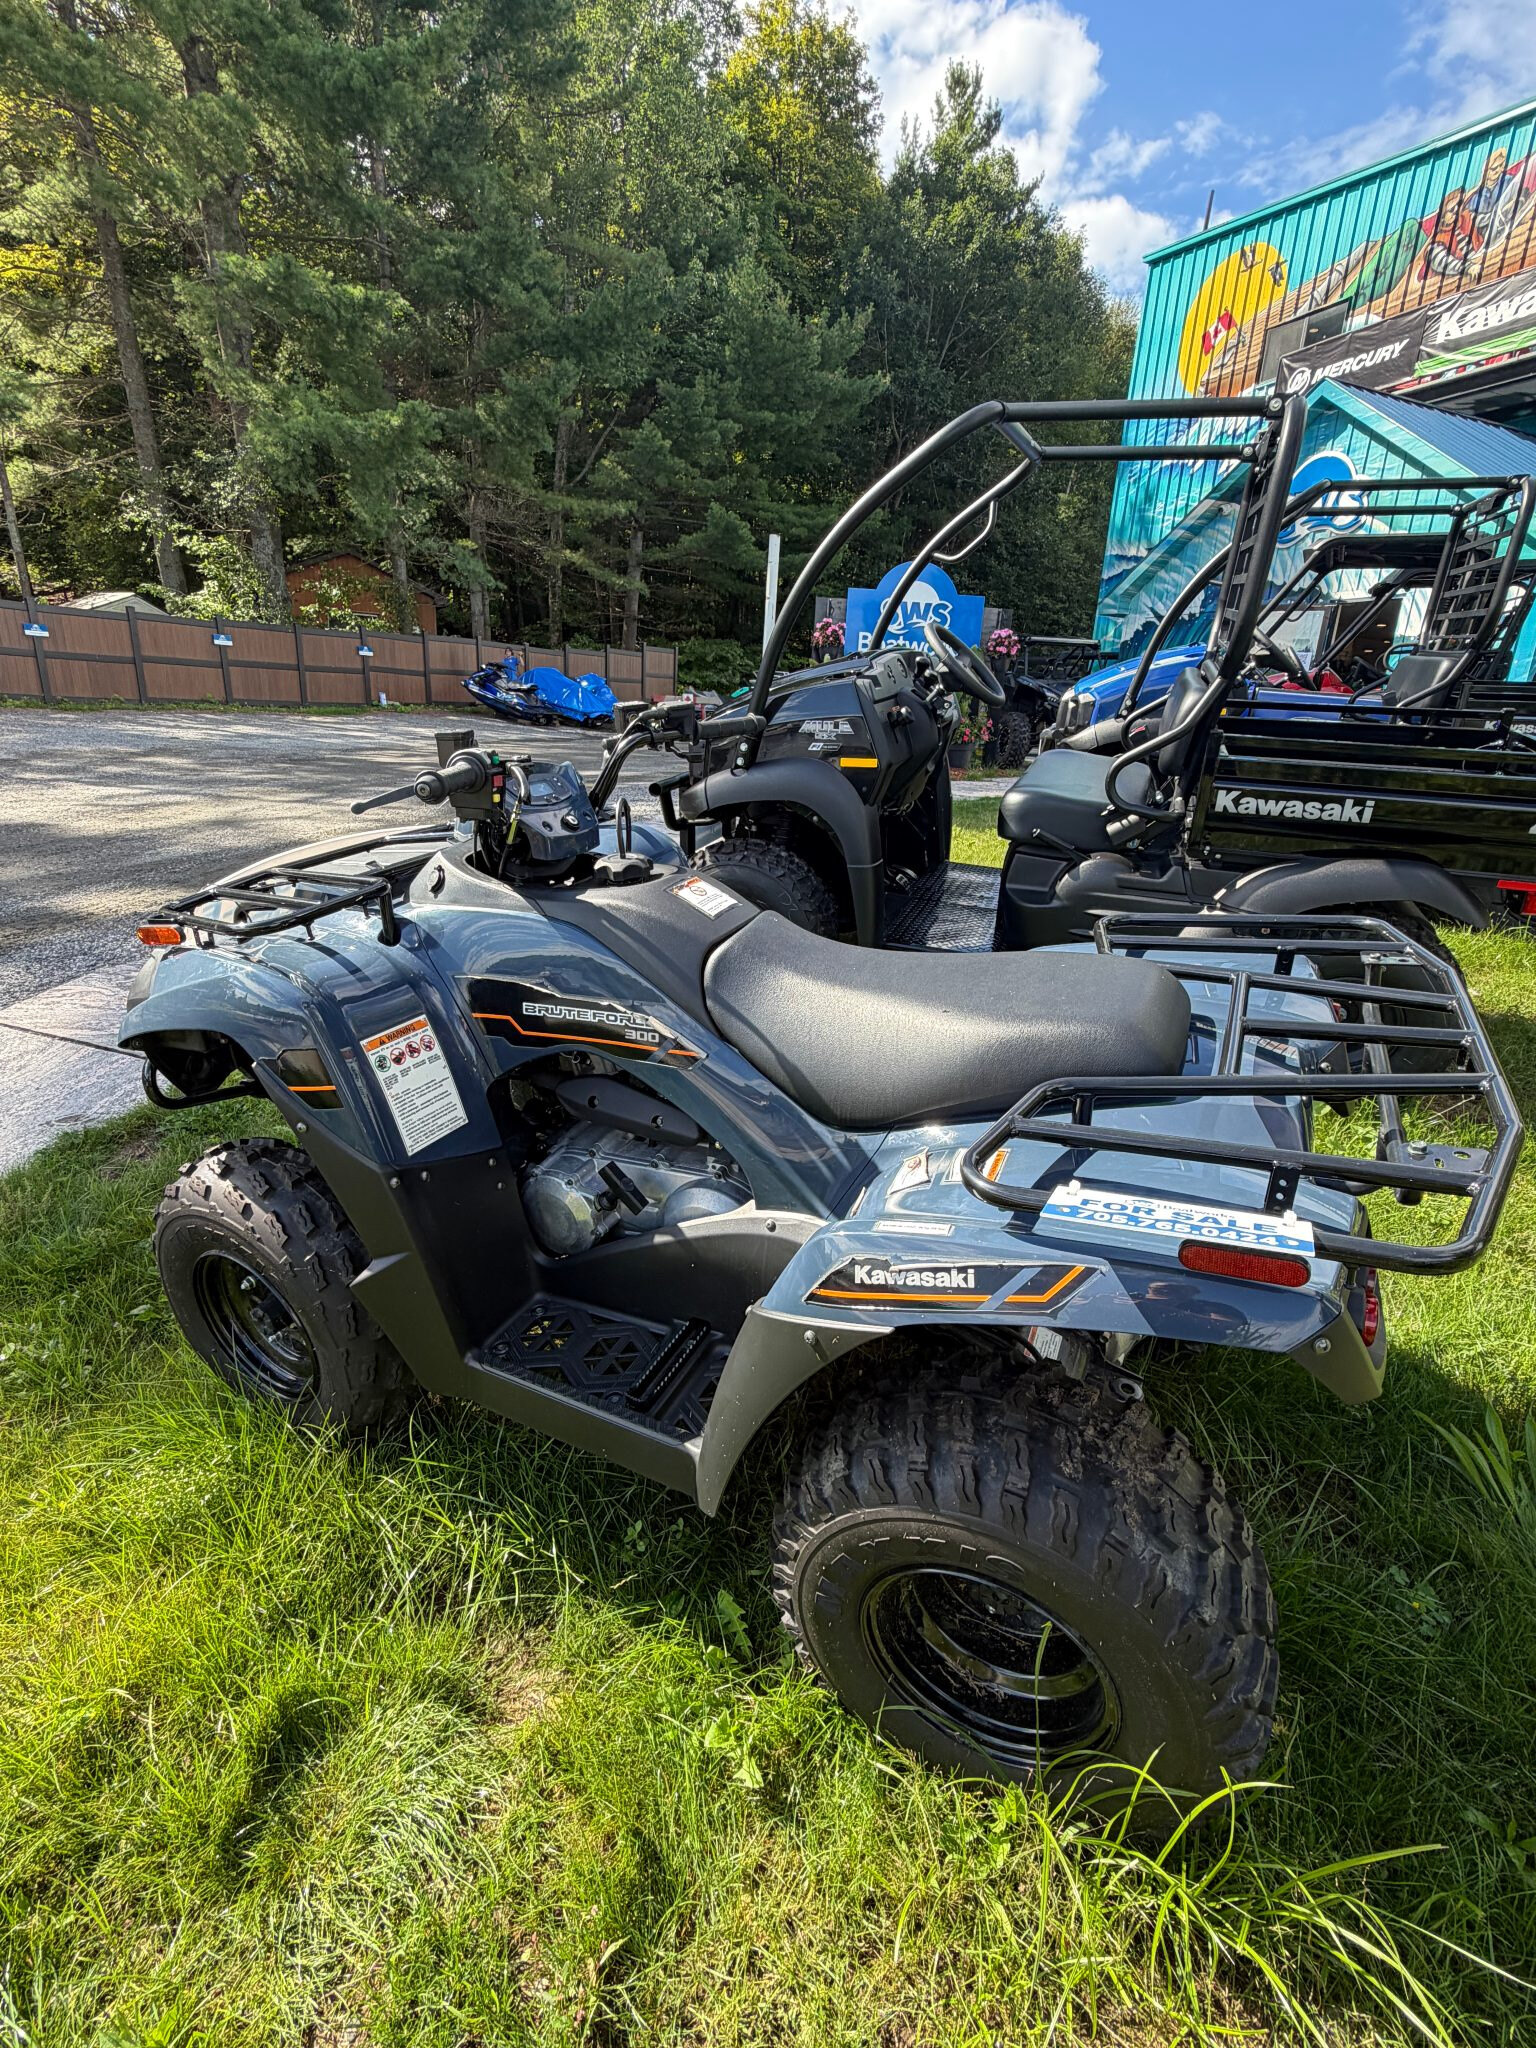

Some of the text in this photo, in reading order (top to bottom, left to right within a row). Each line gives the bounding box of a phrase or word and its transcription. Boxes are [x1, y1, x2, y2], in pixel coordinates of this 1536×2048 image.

[1311, 338, 1410, 385] MERCURY
[799, 720, 855, 735] MULE
[1214, 789, 1376, 824] Kawasaki
[522, 1001, 591, 1022] BRUTE
[386, 1024, 416, 1041] WARNING
[624, 1029, 660, 1043] 300
[1077, 1208, 1279, 1246] 705.765.0424
[1080, 1198, 1281, 1234] FOR SALE
[854, 1264, 975, 1288] Kawasaki
